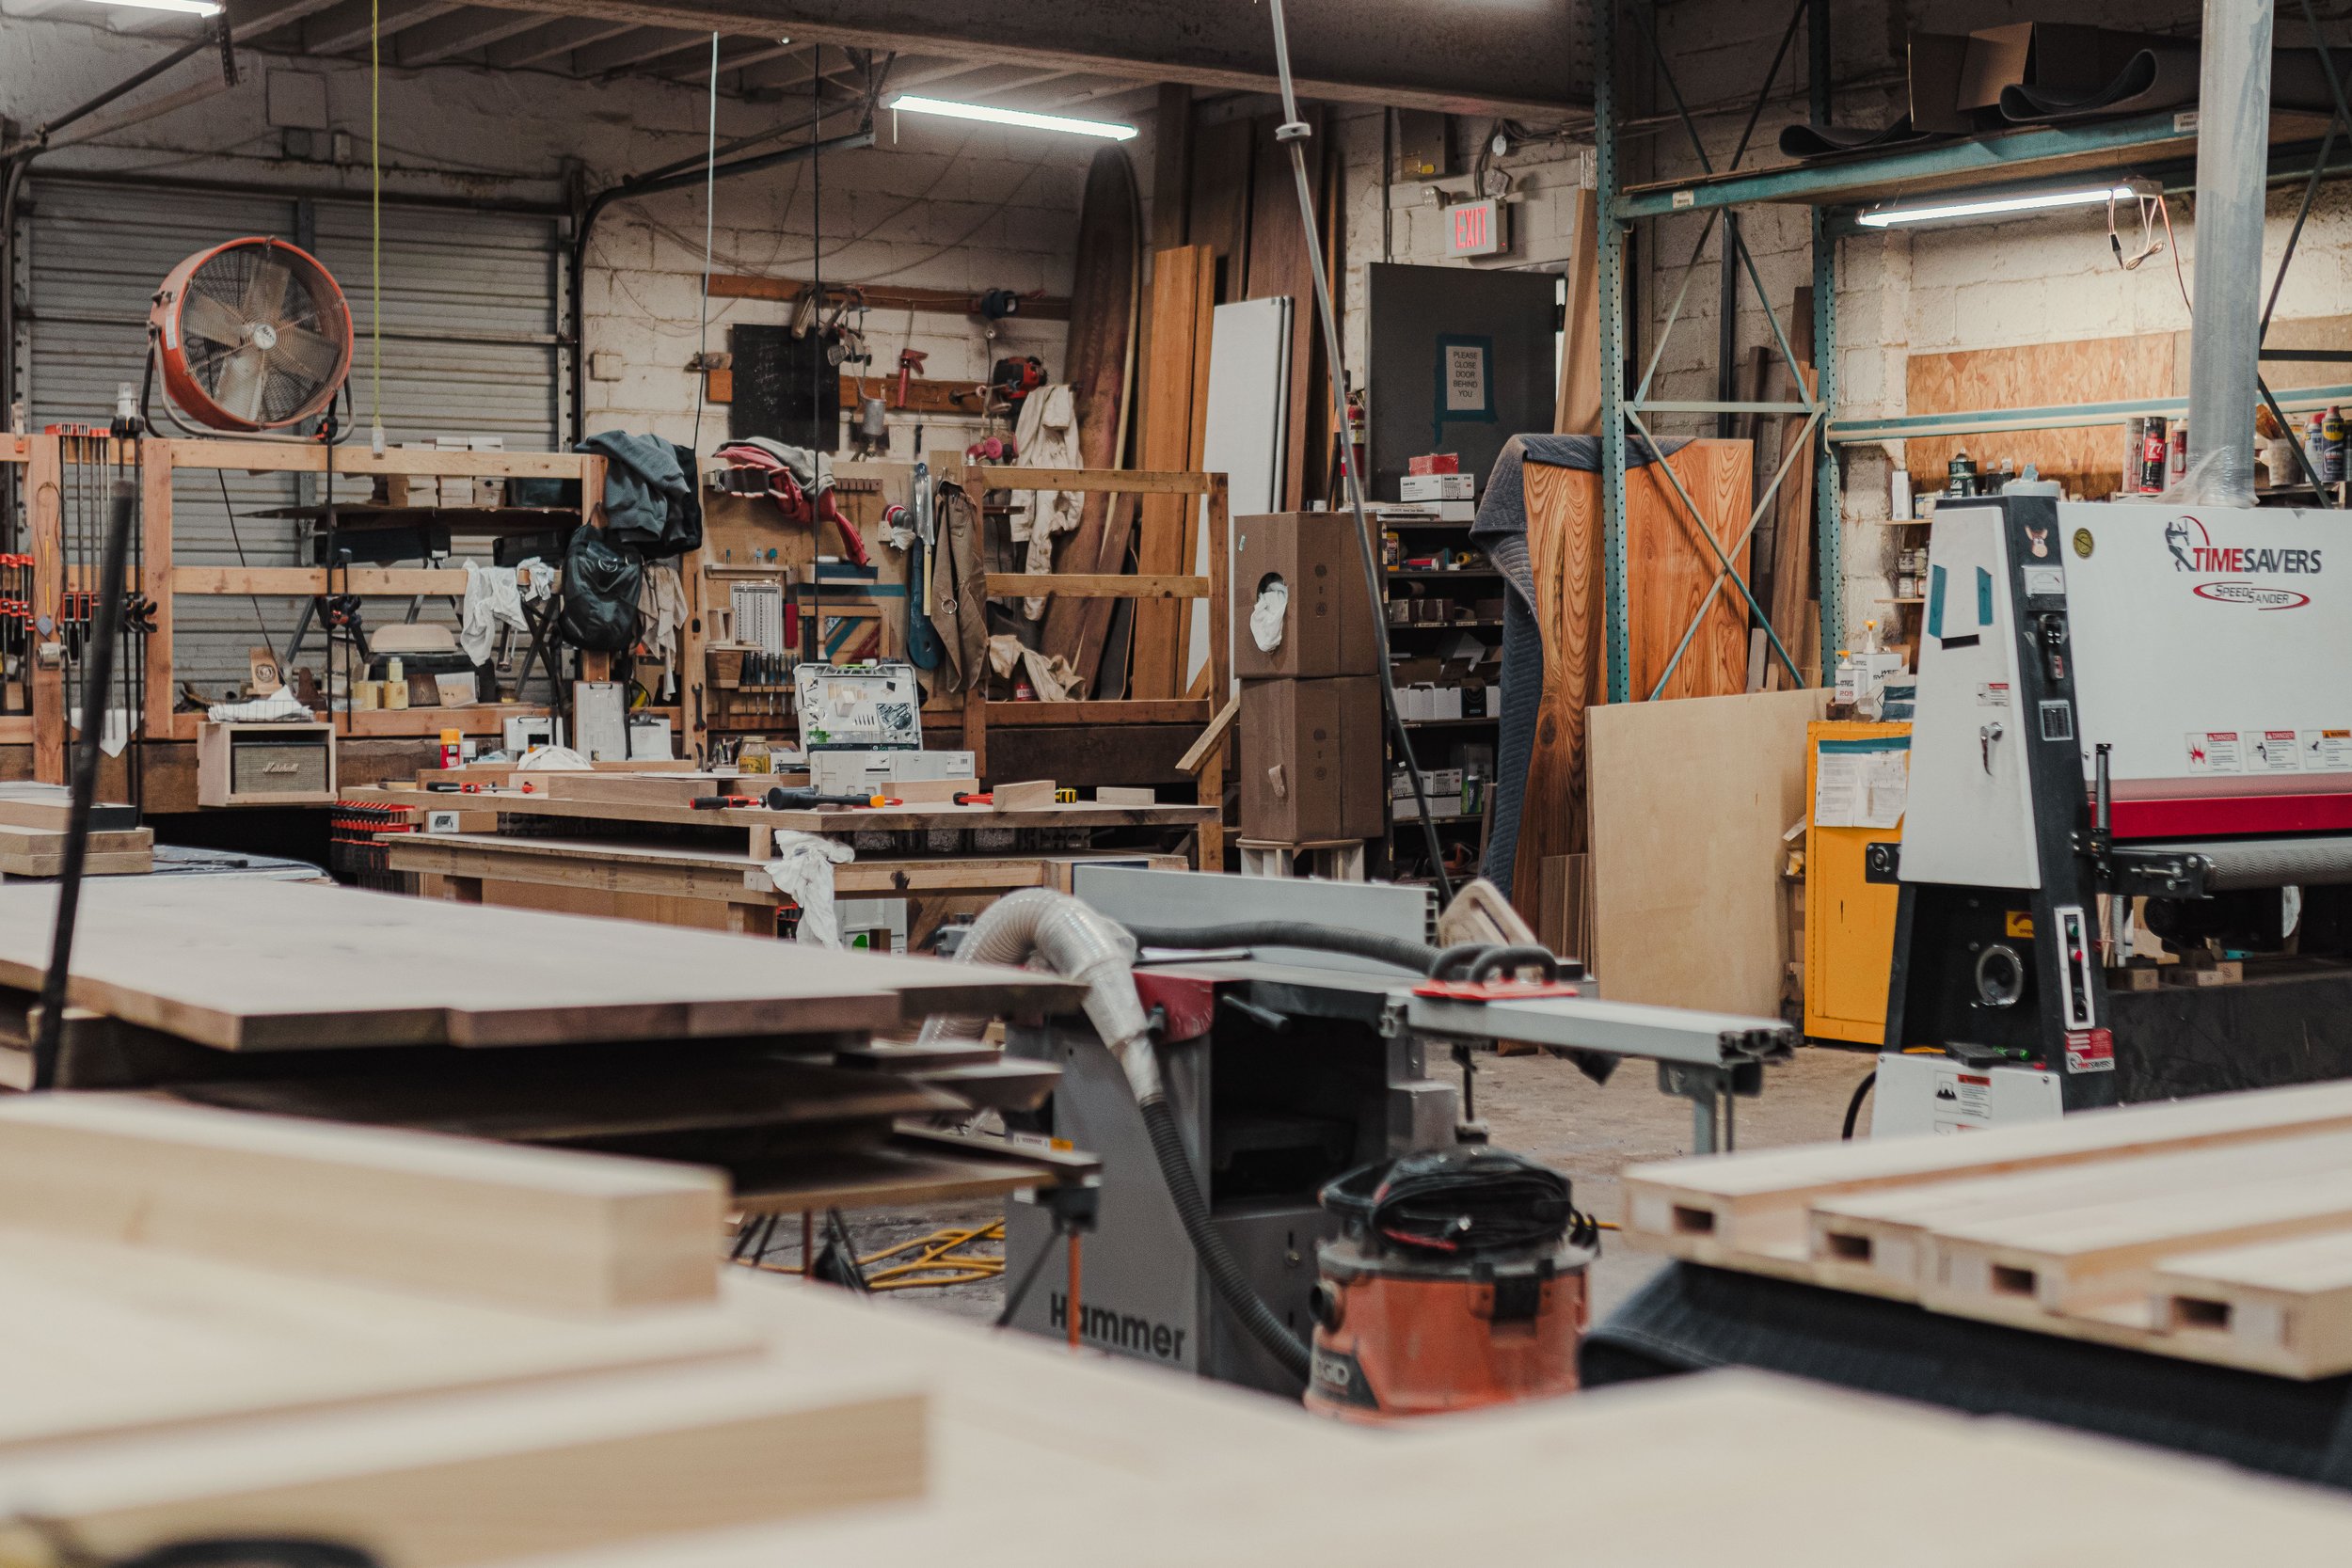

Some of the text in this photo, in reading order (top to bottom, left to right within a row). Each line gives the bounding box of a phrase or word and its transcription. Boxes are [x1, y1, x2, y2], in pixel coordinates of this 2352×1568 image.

[1455, 206, 1487, 249] EXIT
[1453, 351, 1478, 359] PLEASE
[1454, 360, 1476, 369] CLOSE
[2149, 443, 2163, 454] 77
[2193, 547, 2322, 574] TIMESAVERS
